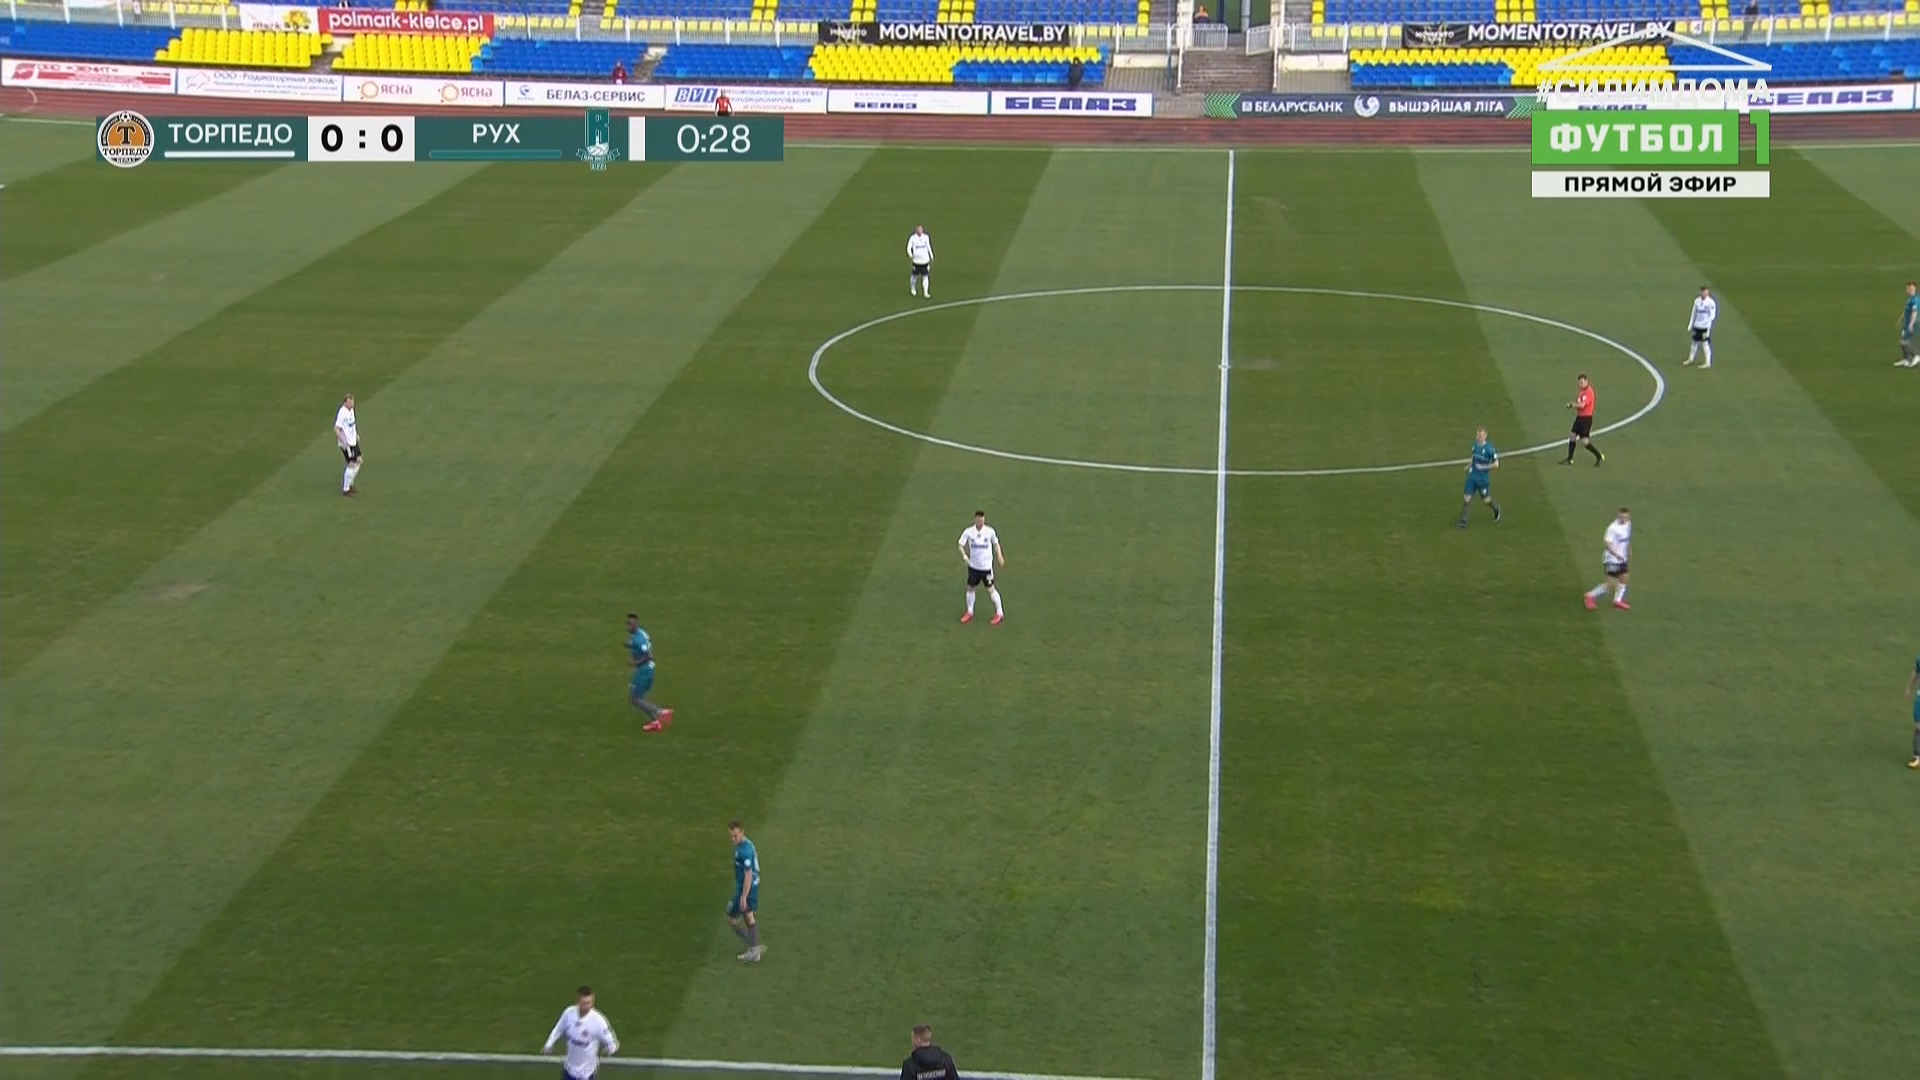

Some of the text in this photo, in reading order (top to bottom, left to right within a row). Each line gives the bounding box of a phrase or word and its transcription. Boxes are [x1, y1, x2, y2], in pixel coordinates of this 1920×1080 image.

[328, 12, 484, 31] polmark-kielce.pl
[879, 23, 1066, 42] MOMENTOTRAVEL.BY
[1467, 22, 1672, 41] MOMENTOTRAVEL.BY
[546, 89, 645, 102] БЕЛАЗ-СЕРВИС
[675, 88, 718, 103] BVI
[1005, 97, 1137, 111] БЕЛАЗ
[1254, 100, 1343, 113] БЕЛАРУСБАНК
[1388, 99, 1505, 113] ВЫШЭЙШАЯ ЛІГА
